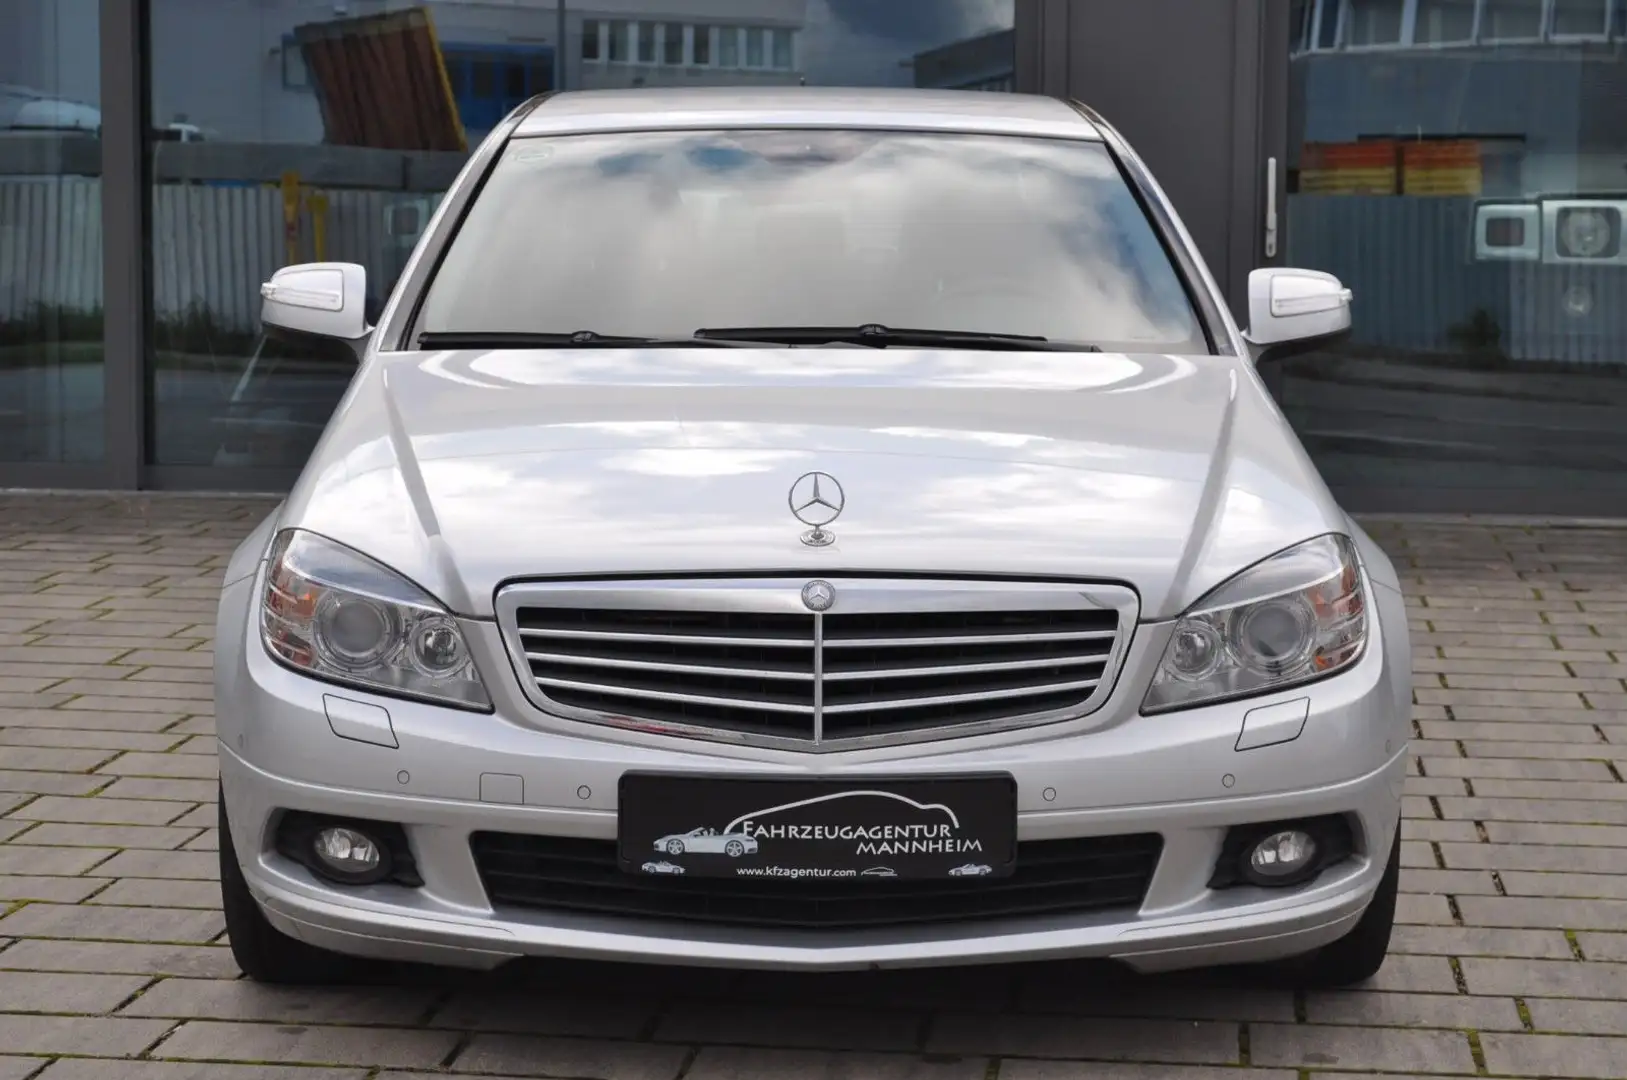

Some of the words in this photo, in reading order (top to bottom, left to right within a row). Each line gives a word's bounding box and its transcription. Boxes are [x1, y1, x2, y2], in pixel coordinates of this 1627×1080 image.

[743, 820, 952, 840] FAHRZEUGAGENTUR
[856, 839, 983, 855] MANNHEIM
[736, 865, 857, 878] www.kfzagentur.com
